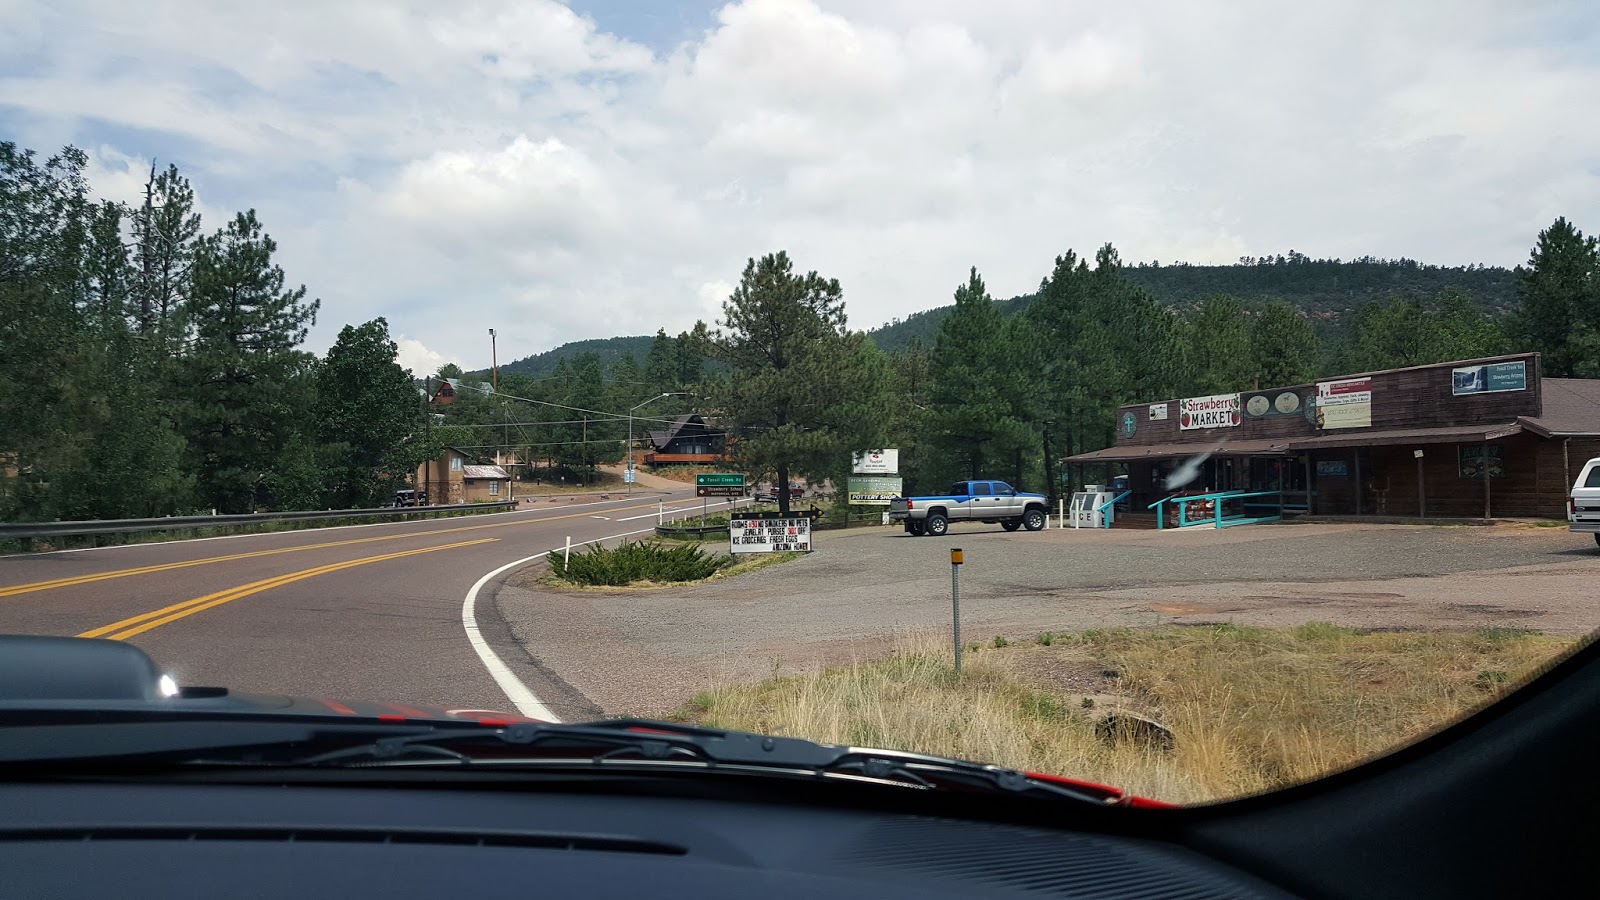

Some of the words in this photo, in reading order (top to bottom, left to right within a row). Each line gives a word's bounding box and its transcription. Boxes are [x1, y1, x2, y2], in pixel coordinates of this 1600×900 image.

[1188, 397, 1234, 411] Strawberry
[1192, 411, 1232, 426] MARKET
[1073, 513, 1091, 521] ICE
[742, 536, 766, 544] GROCERIES
